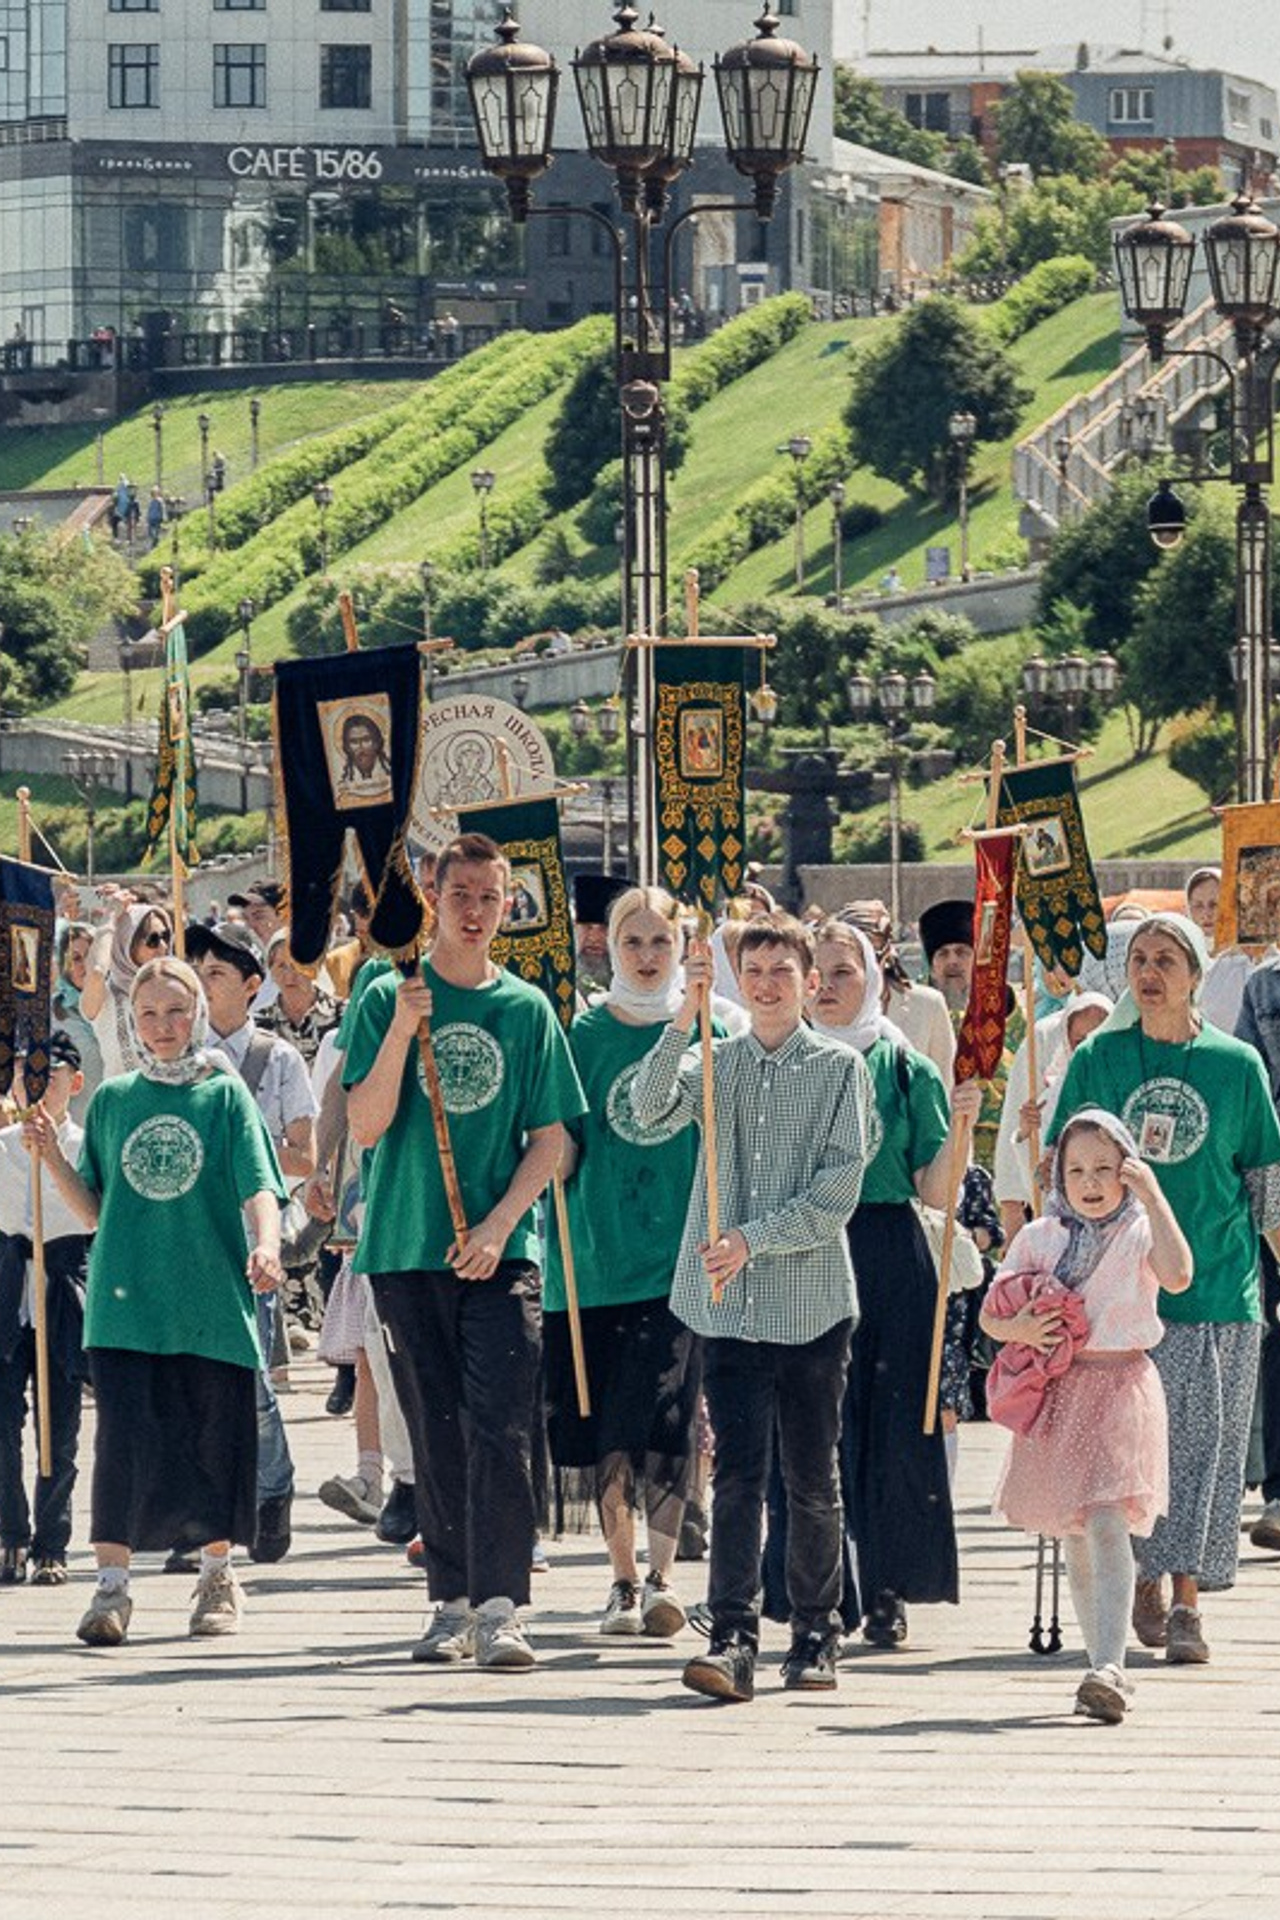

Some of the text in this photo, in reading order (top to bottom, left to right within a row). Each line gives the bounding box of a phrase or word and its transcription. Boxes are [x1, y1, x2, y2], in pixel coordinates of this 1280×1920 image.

[228, 146, 383, 180] CAFÉ 15/86
[422, 704, 495, 734] РЕСНАЯ
